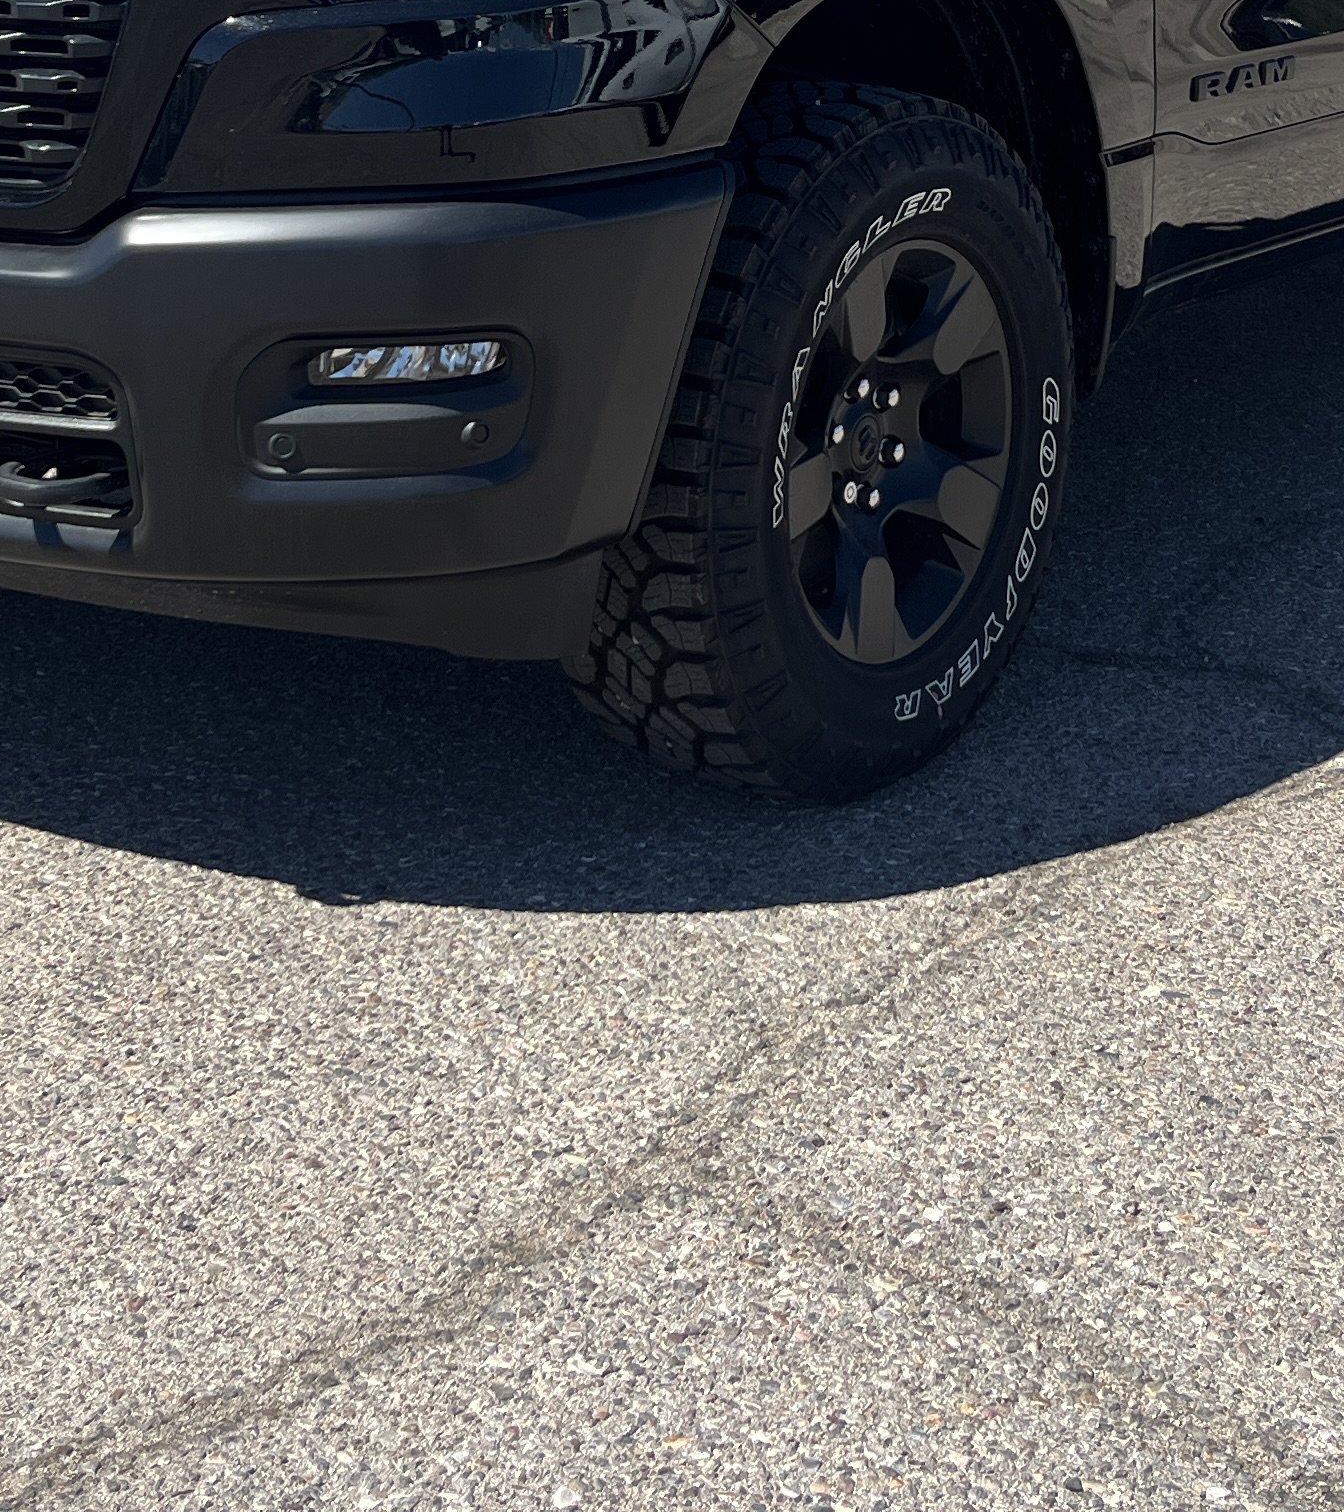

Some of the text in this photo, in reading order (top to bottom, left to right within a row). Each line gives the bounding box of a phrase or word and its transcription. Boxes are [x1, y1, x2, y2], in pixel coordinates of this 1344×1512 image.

[1188, 55, 1297, 102] RAM
[771, 187, 952, 528] WRANGLER
[894, 377, 1060, 721] GOODYEAR
